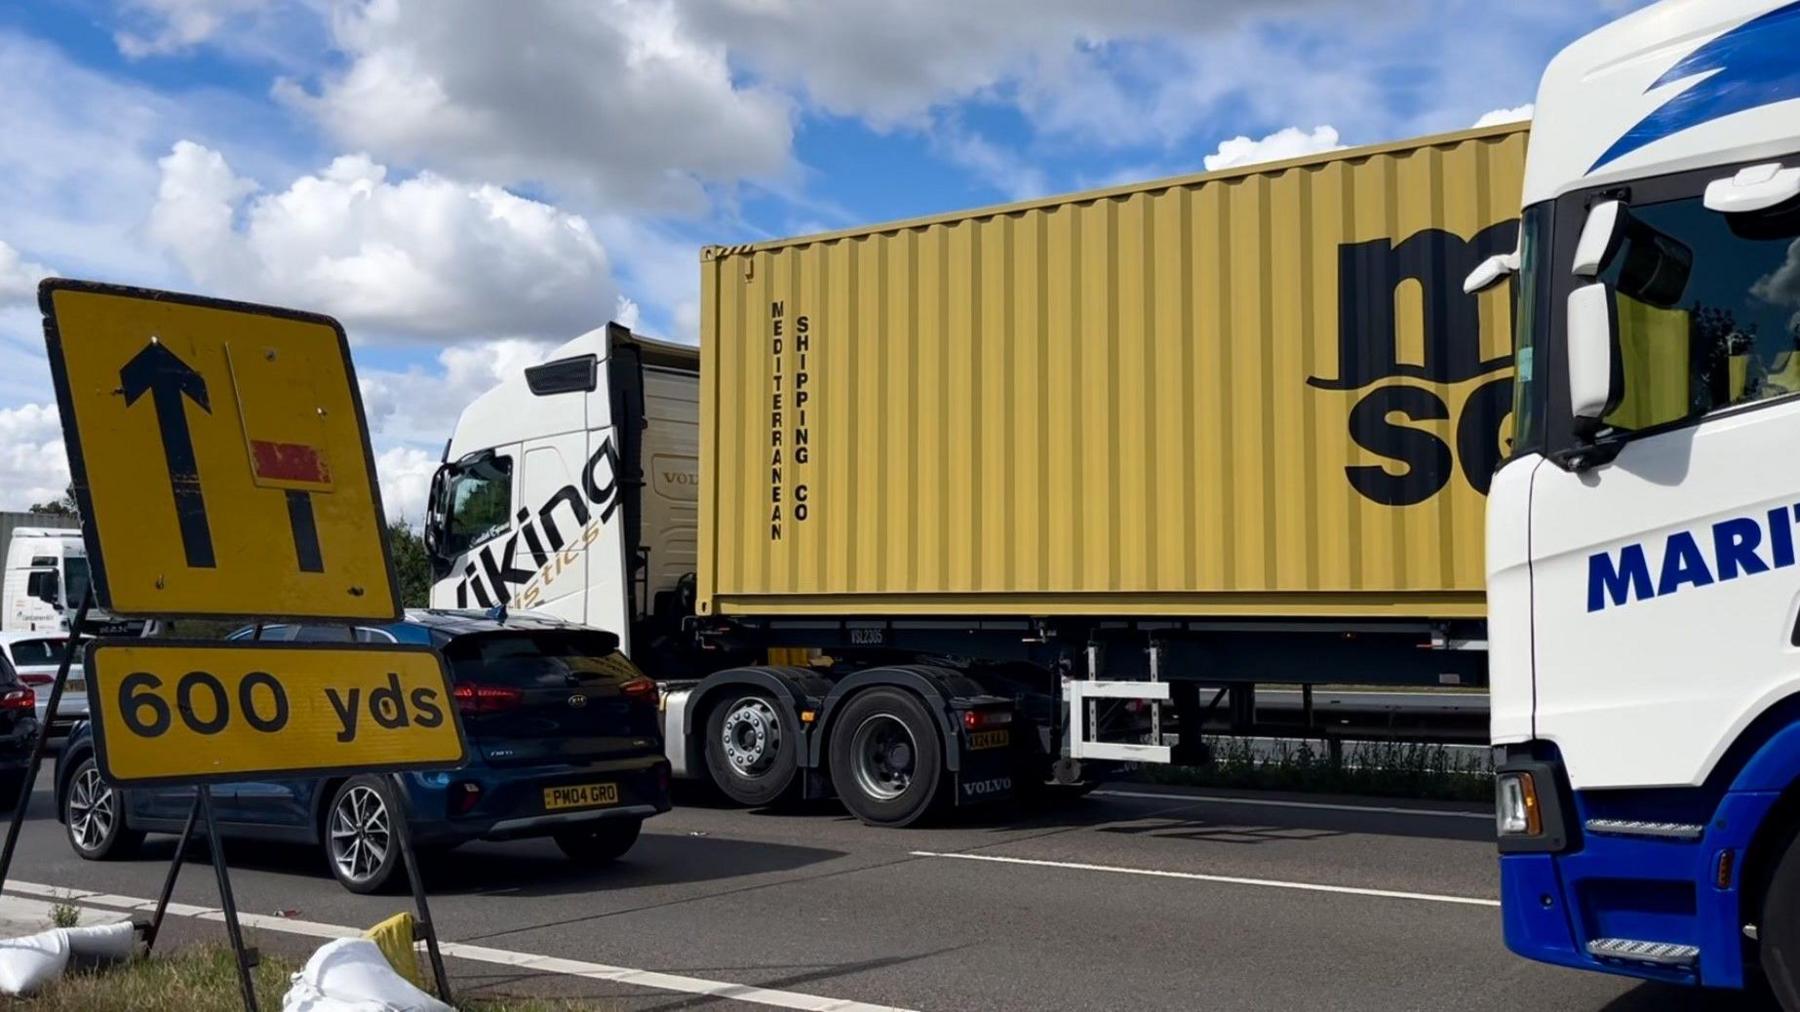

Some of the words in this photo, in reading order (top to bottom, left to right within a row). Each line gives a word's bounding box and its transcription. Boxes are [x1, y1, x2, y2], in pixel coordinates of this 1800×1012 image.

[795, 316, 809, 464] SHIPPING
[771, 301, 784, 540] MEDITERRANEAN
[662, 472, 698, 485] VOL
[794, 485, 808, 521] CO
[508, 520, 600, 609] istics
[118, 671, 289, 739] 600
[325, 672, 443, 743] yds
[553, 787, 588, 806] PM04
[963, 777, 1011, 795] VOLVO
